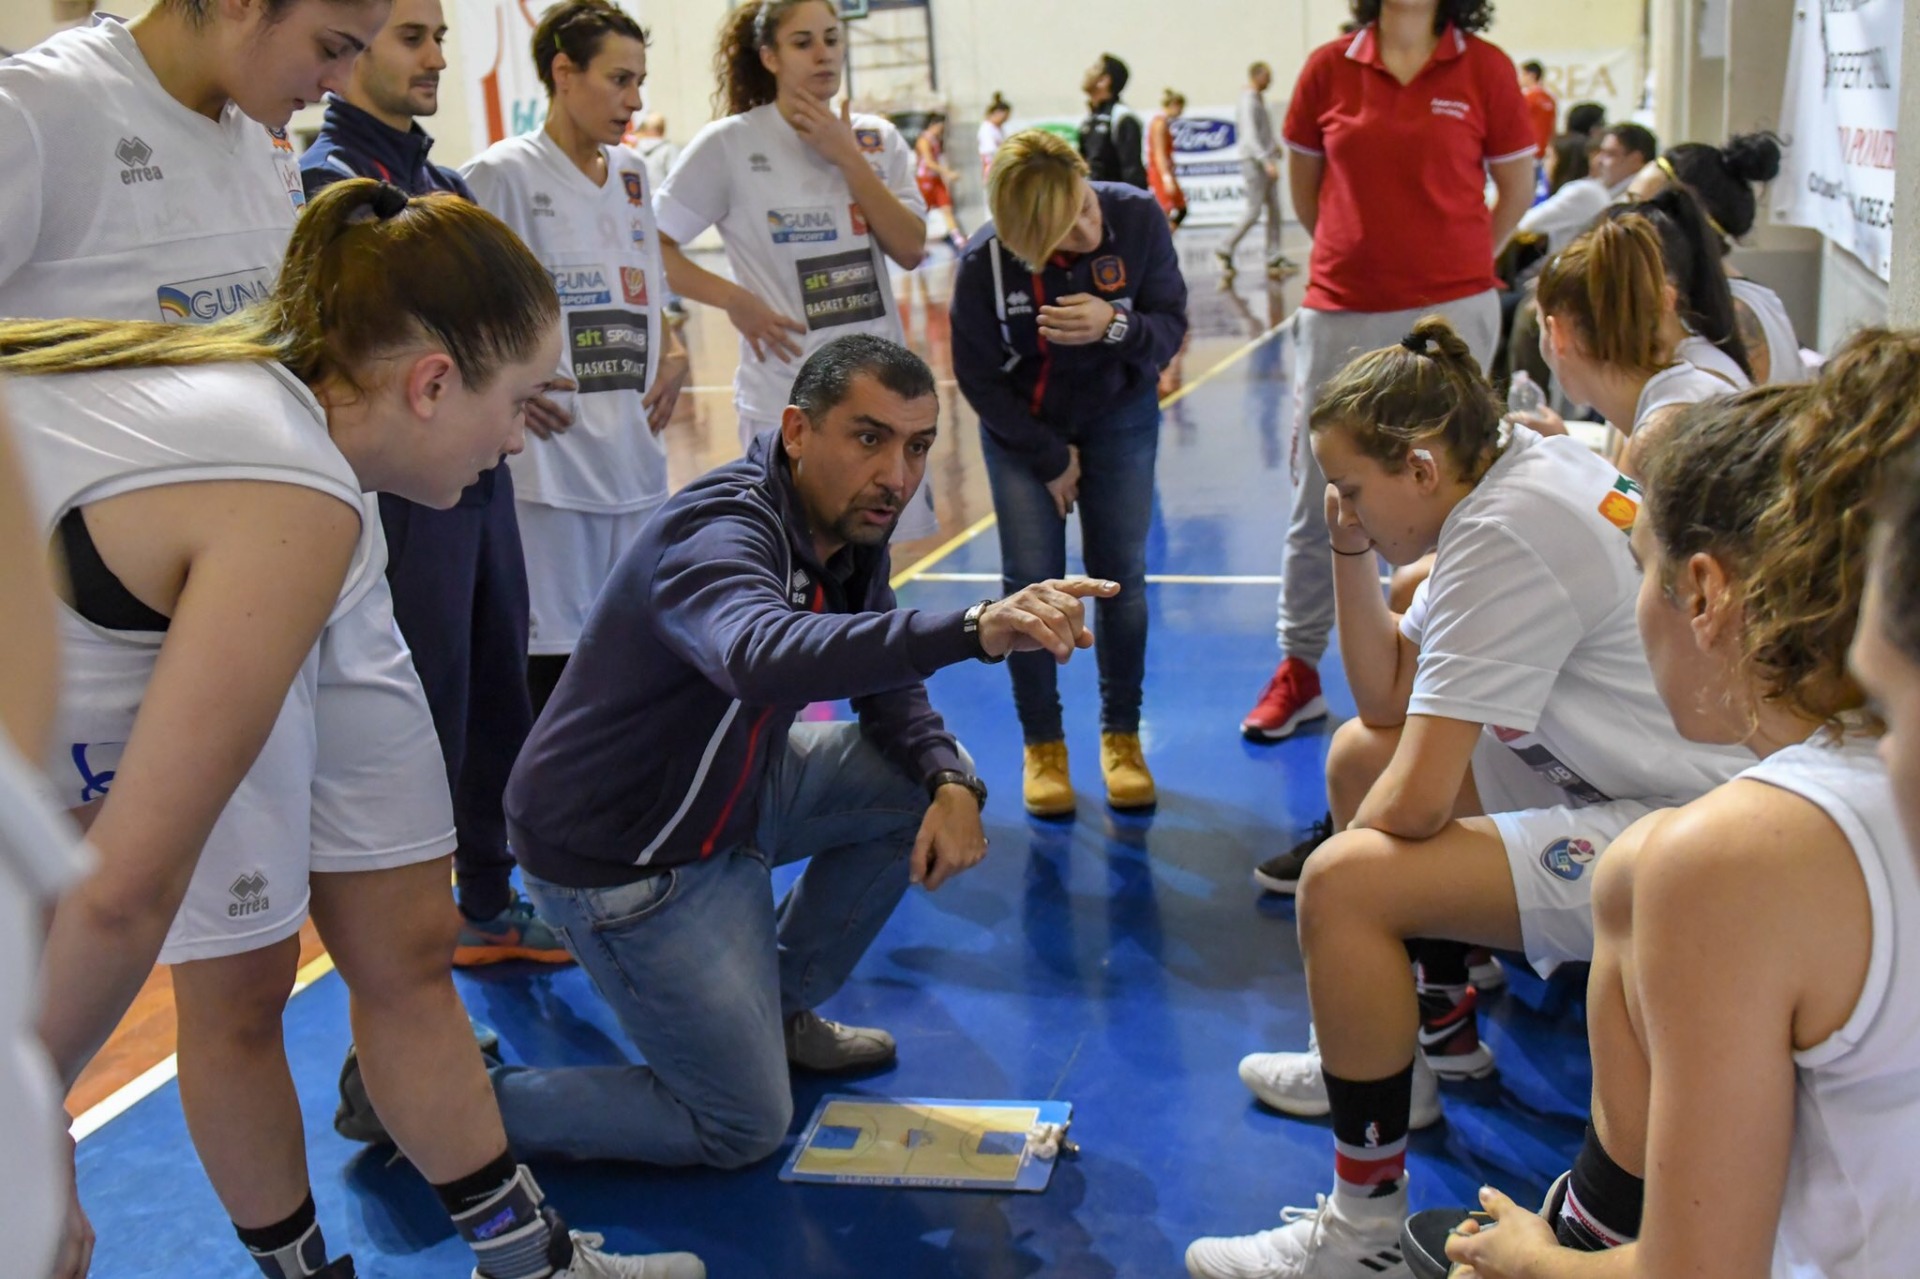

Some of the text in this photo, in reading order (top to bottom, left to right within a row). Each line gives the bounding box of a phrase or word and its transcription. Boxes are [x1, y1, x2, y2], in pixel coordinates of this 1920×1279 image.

[120, 165, 164, 185] errea
[574, 359, 618, 377] BASKET
[228, 896, 269, 917] errea
